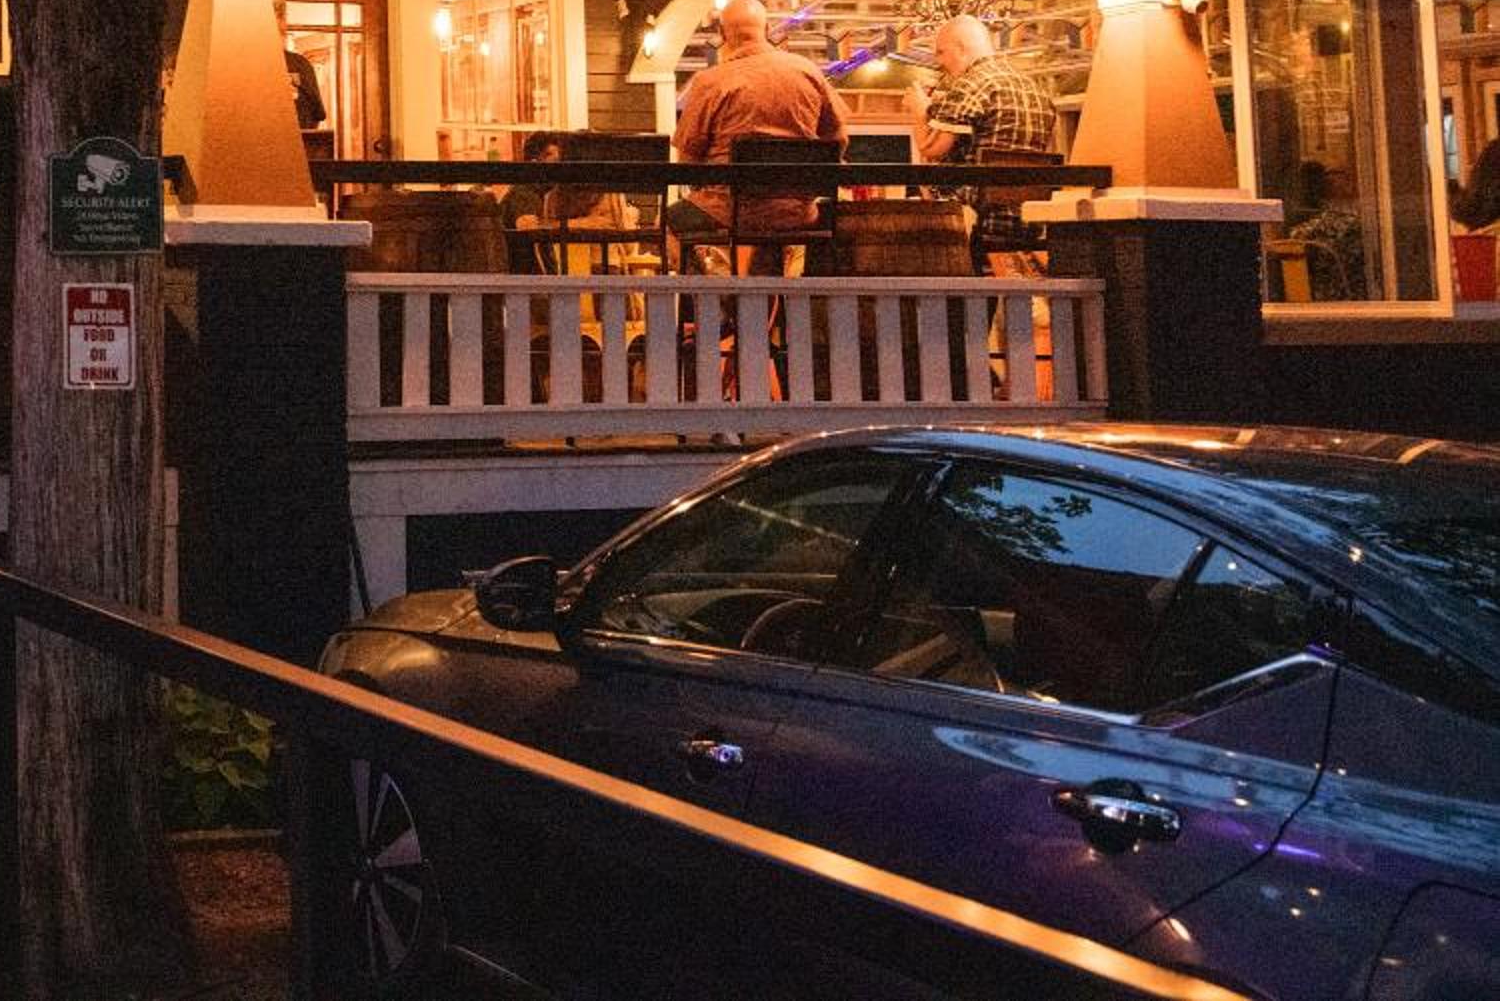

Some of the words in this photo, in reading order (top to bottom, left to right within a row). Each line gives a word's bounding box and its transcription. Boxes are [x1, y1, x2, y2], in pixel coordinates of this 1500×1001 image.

[61, 196, 115, 208] SECURITY
[117, 196, 151, 208] ALERT
[90, 290, 108, 304] NO
[73, 309, 124, 323] OUTSIDE
[83, 328, 115, 342] FOOD
[89, 348, 107, 361] OR
[81, 367, 119, 380] DRINK
